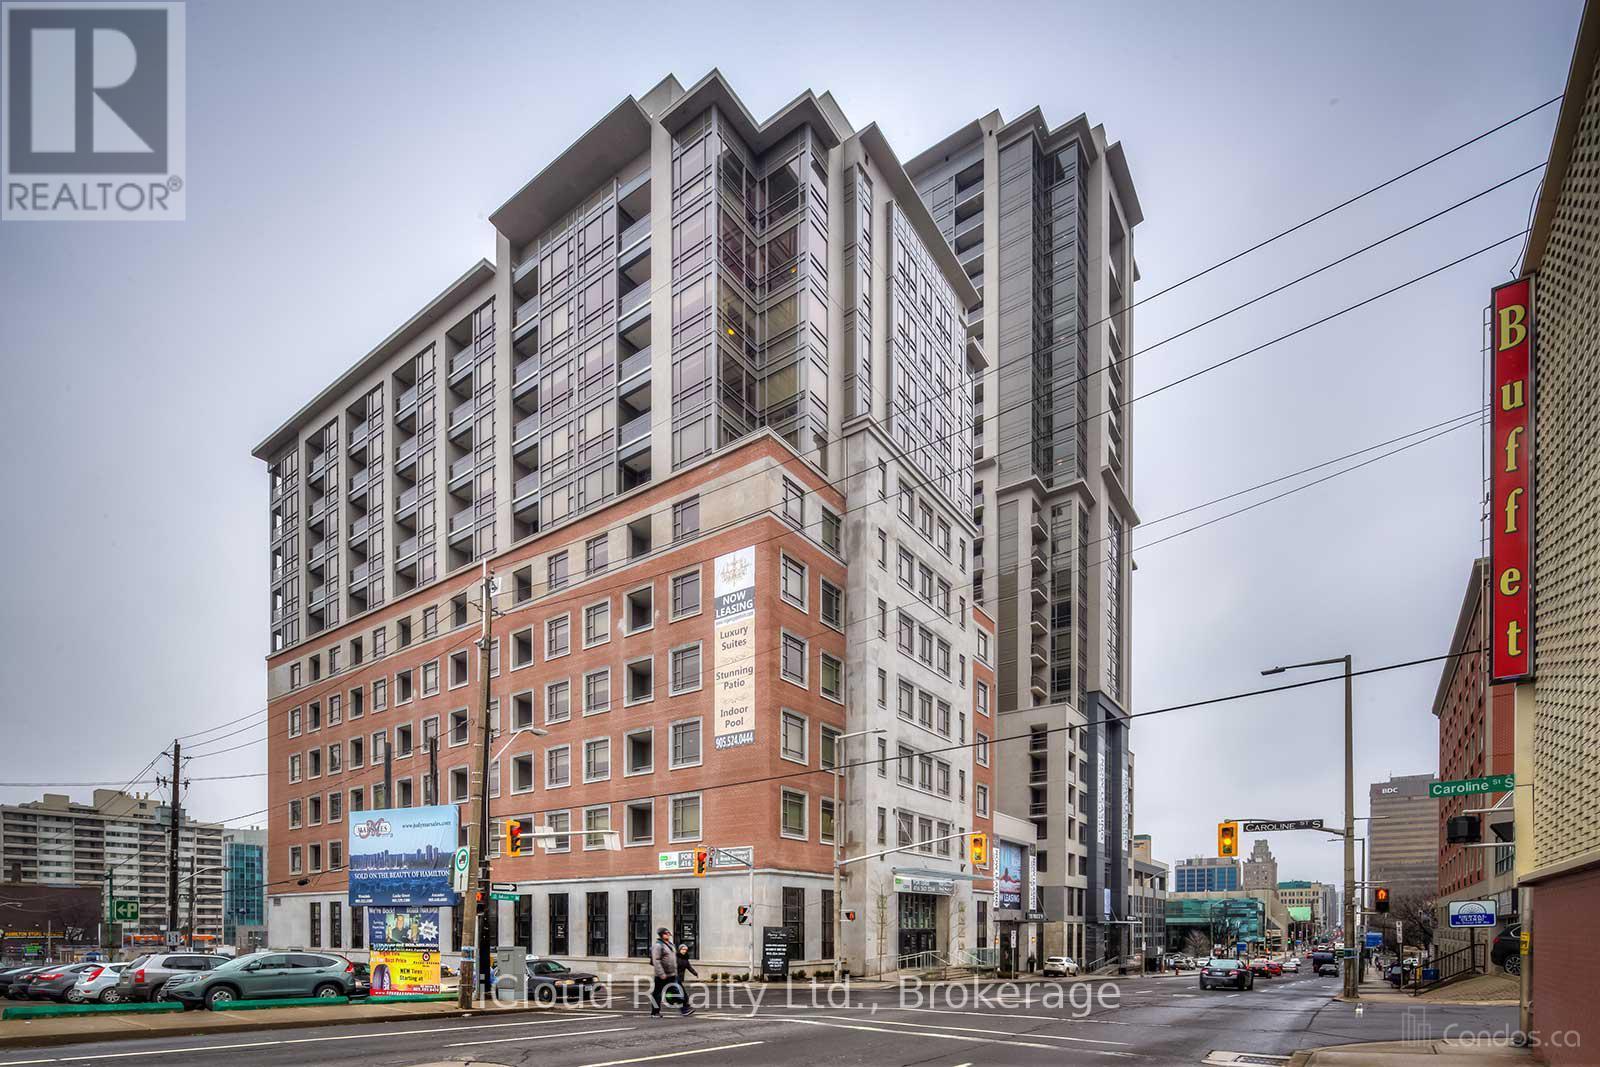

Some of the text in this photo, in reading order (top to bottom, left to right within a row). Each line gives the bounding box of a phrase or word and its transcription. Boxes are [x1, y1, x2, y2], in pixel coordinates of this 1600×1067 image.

[1498, 304, 1527, 657] Buffet
[722, 590, 746, 606] NOW
[715, 599, 753, 618] LEASING
[720, 625, 749, 640] Luxury
[721, 638, 747, 651] Suites
[716, 666, 753, 681] Stunning
[723, 678, 745, 690] Patio
[720, 705, 748, 718] Indoor
[725, 717, 744, 728] Pool
[715, 731, 753, 749] 905.524.0444
[1432, 782, 1489, 795] Caroline
[1504, 777, 1514, 788] S
[1246, 822, 1296, 832] CAROLINE
[1311, 820, 1321, 829] S
[390, 871, 412, 879] BEAUTY
[420, 869, 450, 878] HAMILTON
